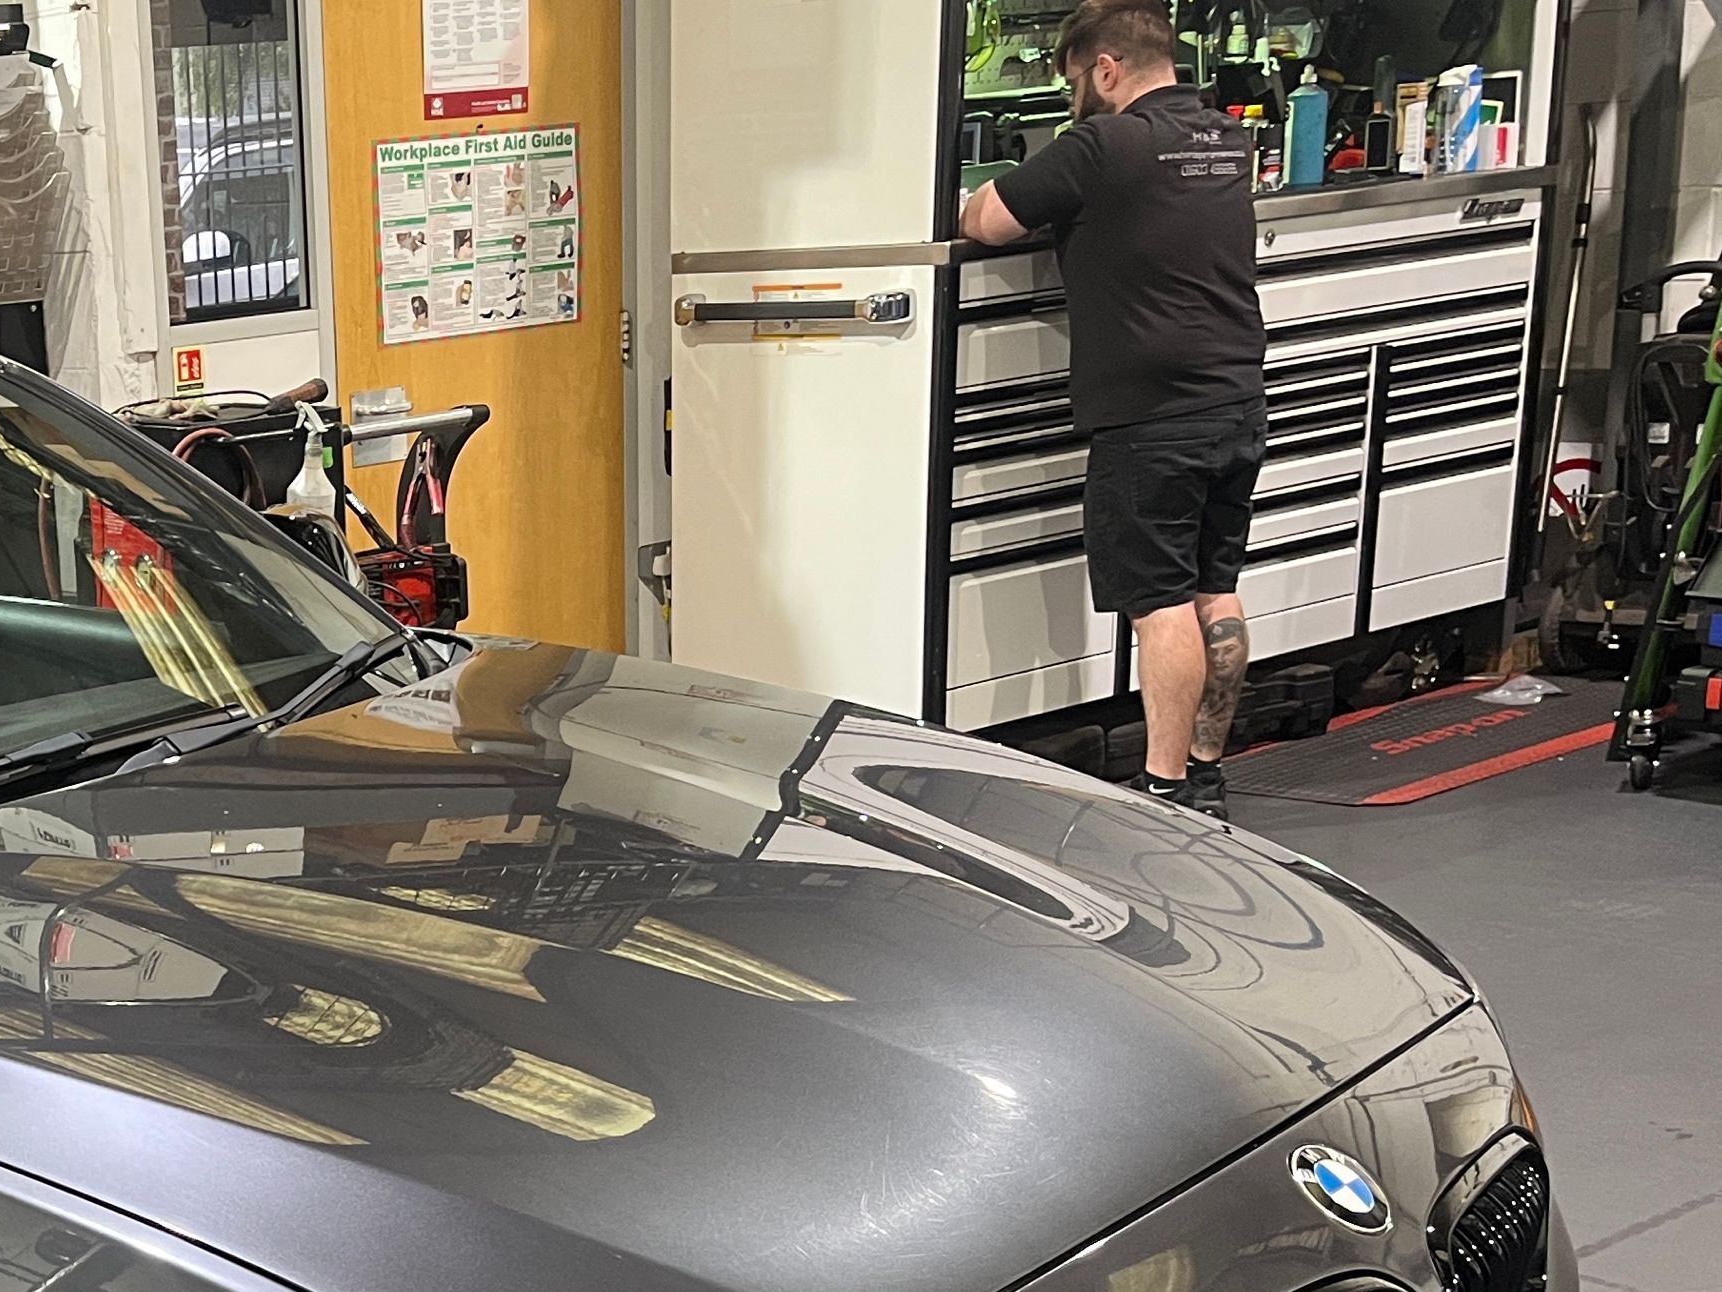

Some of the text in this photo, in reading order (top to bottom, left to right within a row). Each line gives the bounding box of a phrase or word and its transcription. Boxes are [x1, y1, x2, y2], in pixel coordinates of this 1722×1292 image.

[379, 131, 572, 162] Workplace First Aid Guide
